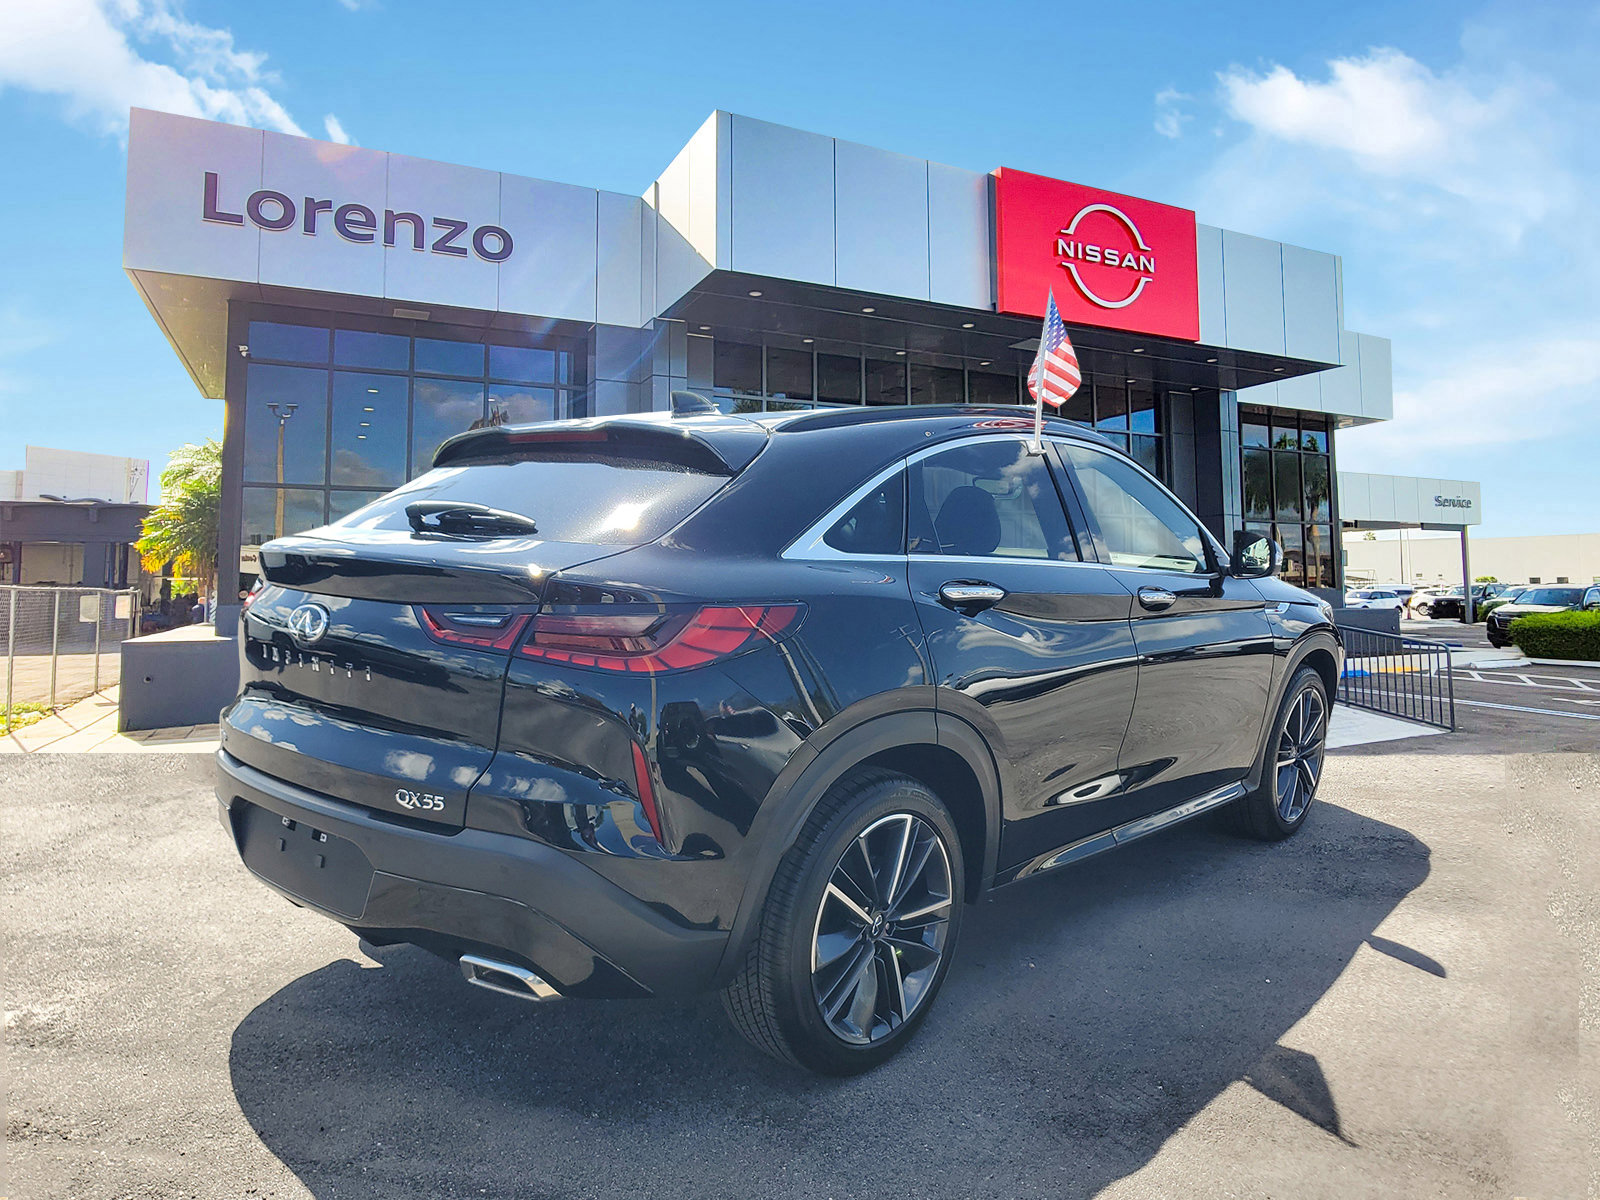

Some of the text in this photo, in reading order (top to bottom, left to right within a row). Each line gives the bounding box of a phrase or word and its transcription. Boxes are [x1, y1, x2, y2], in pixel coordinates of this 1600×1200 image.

[202, 171, 515, 262] Lorenzo
[1057, 238, 1155, 273] NISSAN
[1434, 495, 1472, 509] Service
[395, 788, 445, 811] QX55
